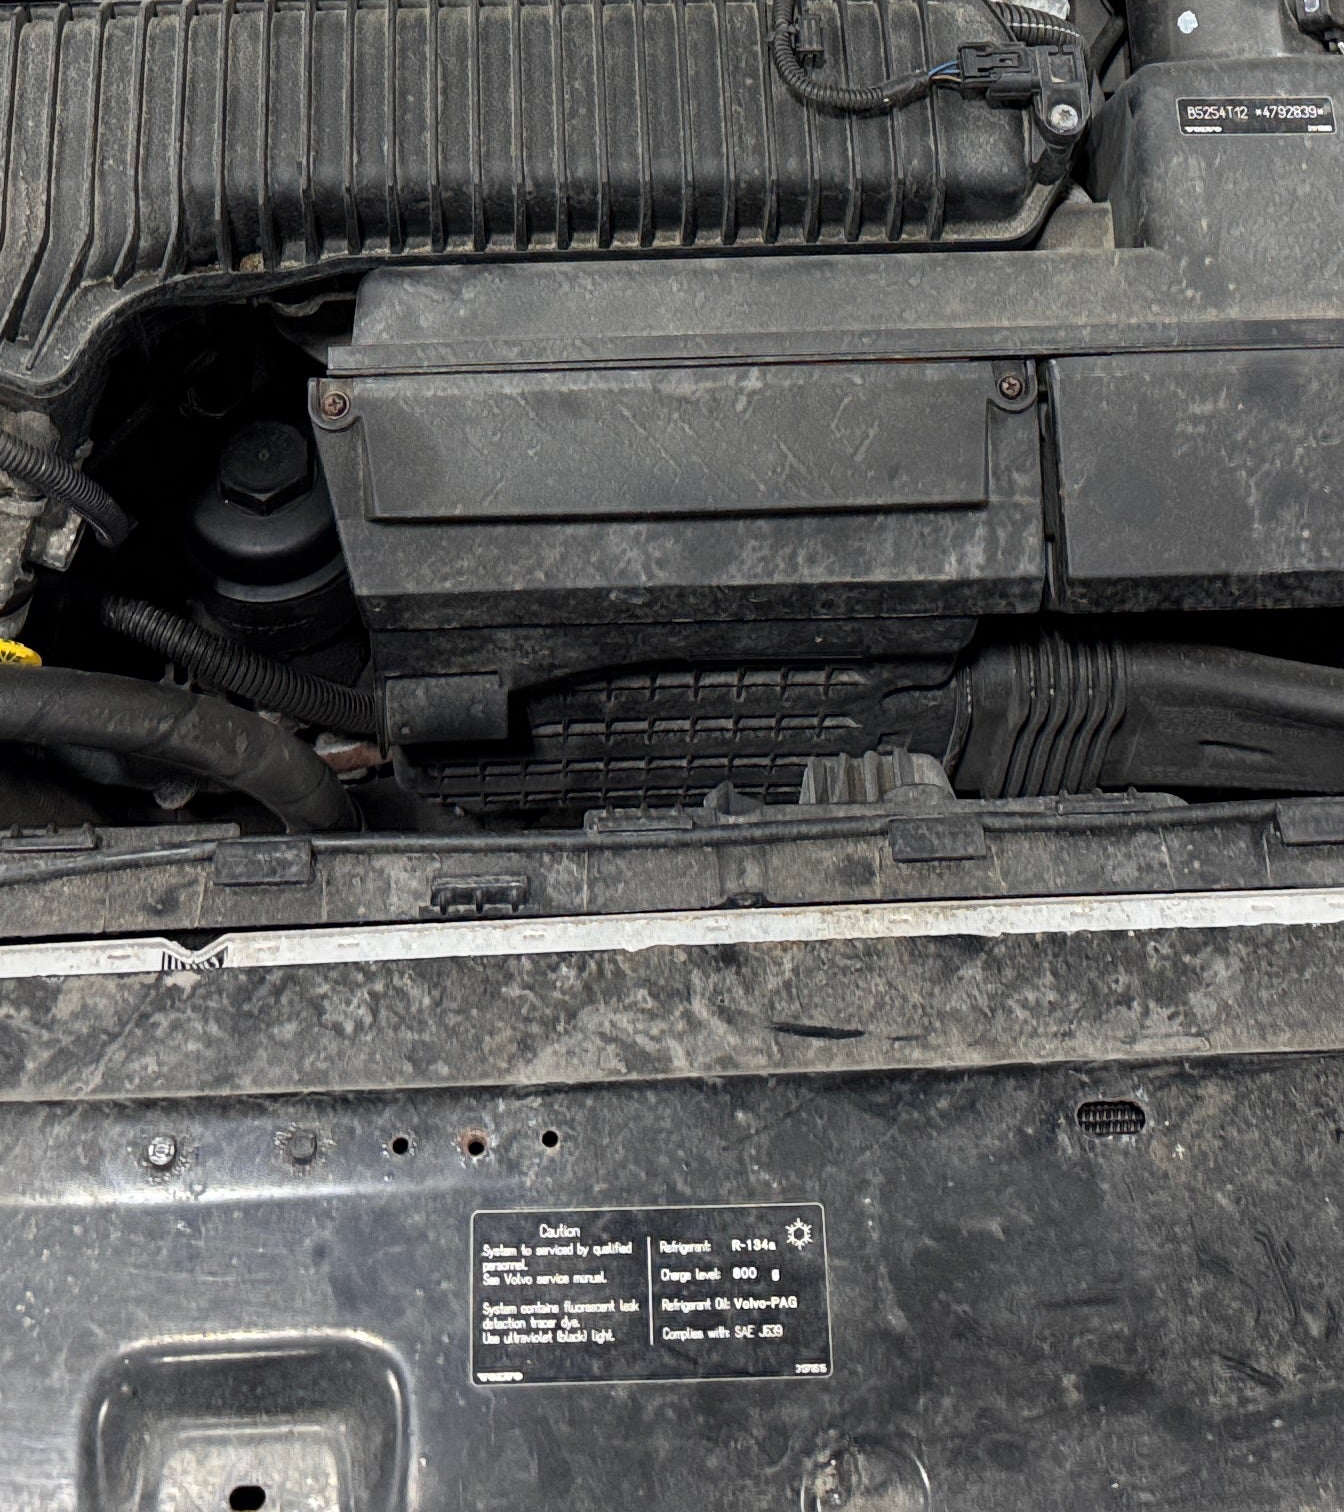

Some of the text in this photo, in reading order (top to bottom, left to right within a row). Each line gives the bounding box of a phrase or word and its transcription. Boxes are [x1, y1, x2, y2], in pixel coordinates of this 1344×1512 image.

[1186, 105, 1249, 120] B5254T12
[539, 1224, 581, 1239] Caution
[481, 1241, 633, 1259] System to serviced by qualified
[659, 1238, 777, 1255] Refrigerant: R-134a
[482, 1258, 529, 1273] personnel.
[482, 1273, 501, 1286] See
[504, 1272, 533, 1285] Volvo
[536, 1272, 570, 1285] service
[660, 1268, 692, 1283] Charge
[695, 1267, 722, 1281] level:
[482, 1298, 641, 1317] System contains fluorescent leak
[661, 1297, 712, 1313] Refrigerant
[733, 1295, 798, 1310] Volvo-PAG
[482, 1315, 580, 1330] detection tracer dye.
[482, 1328, 616, 1345] Use ultraviolet (black) light.
[662, 1326, 705, 1341] Complies
[707, 1325, 731, 1339] with:
[734, 1324, 756, 1338] SAE
